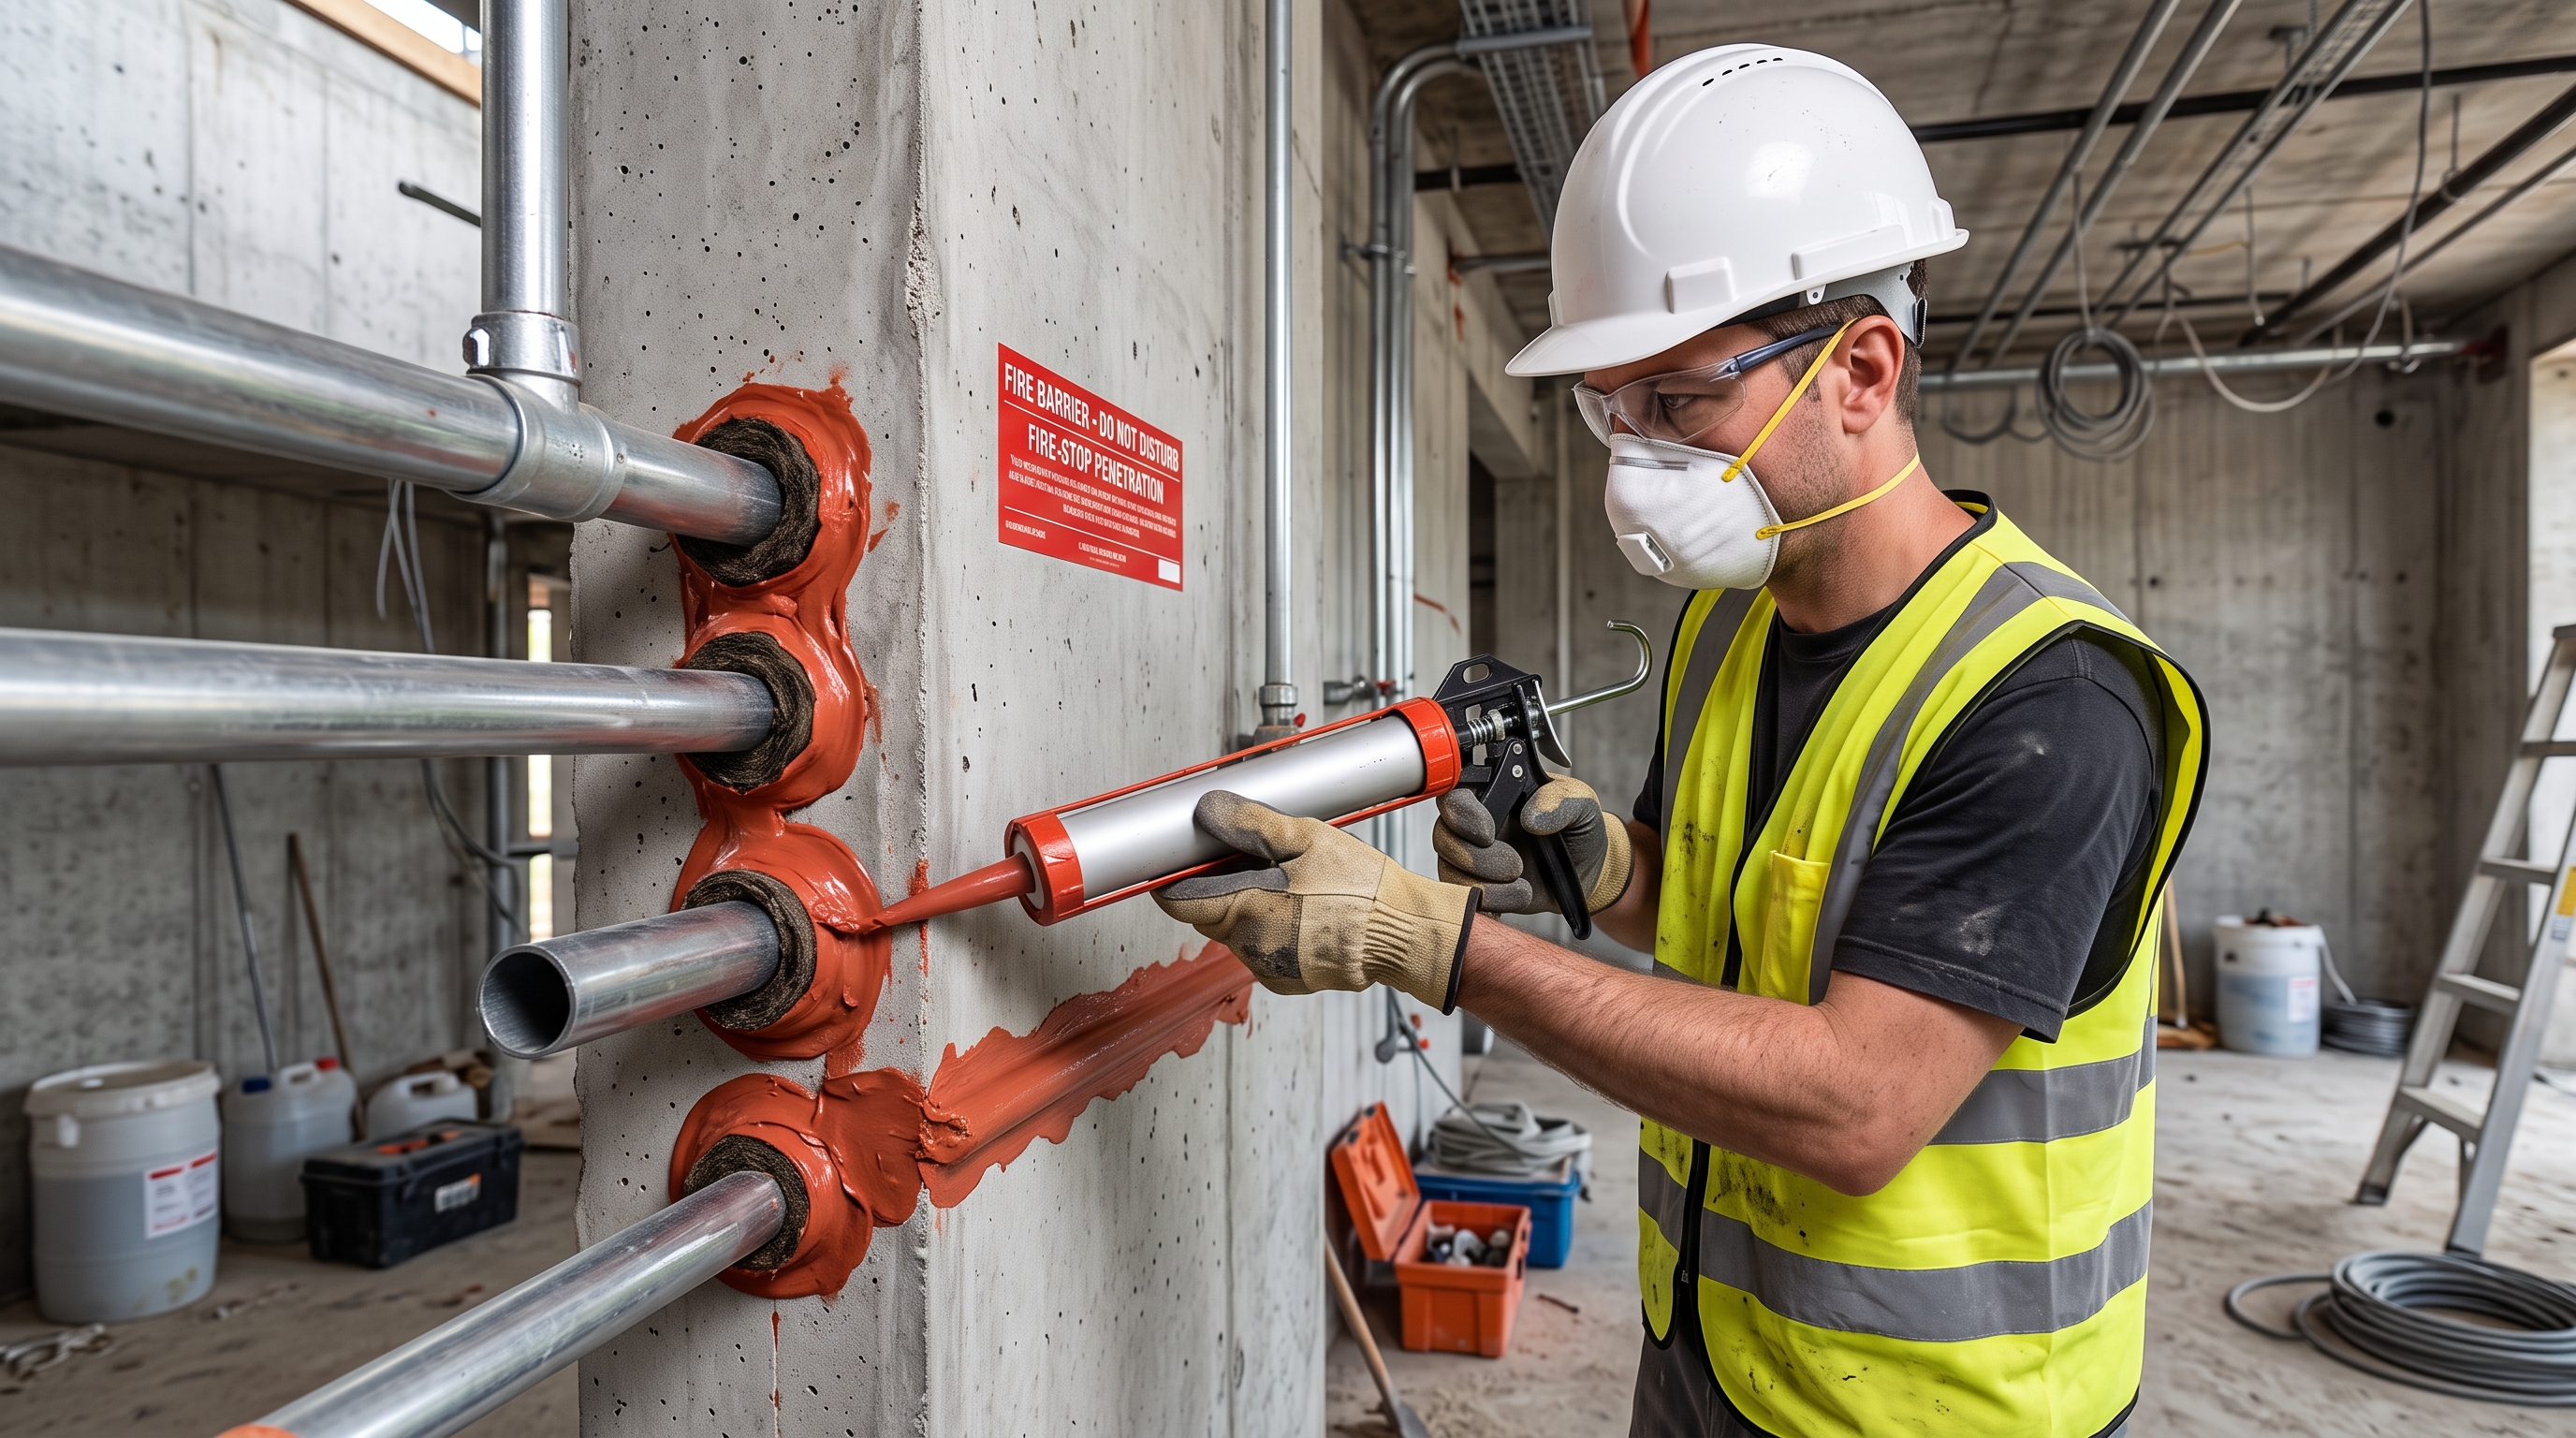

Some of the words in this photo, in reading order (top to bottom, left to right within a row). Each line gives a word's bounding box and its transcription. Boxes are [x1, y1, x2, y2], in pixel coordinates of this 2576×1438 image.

[1004, 362, 1034, 404] FIRE
[1037, 378, 1090, 430] BARRIER
[1099, 410, 1114, 441] DO
[1117, 418, 1137, 452] NOT
[1139, 431, 1179, 473] DISTURB
[1028, 422, 1091, 474] FIRE-STOP
[1094, 451, 1164, 505] PENETRATION
